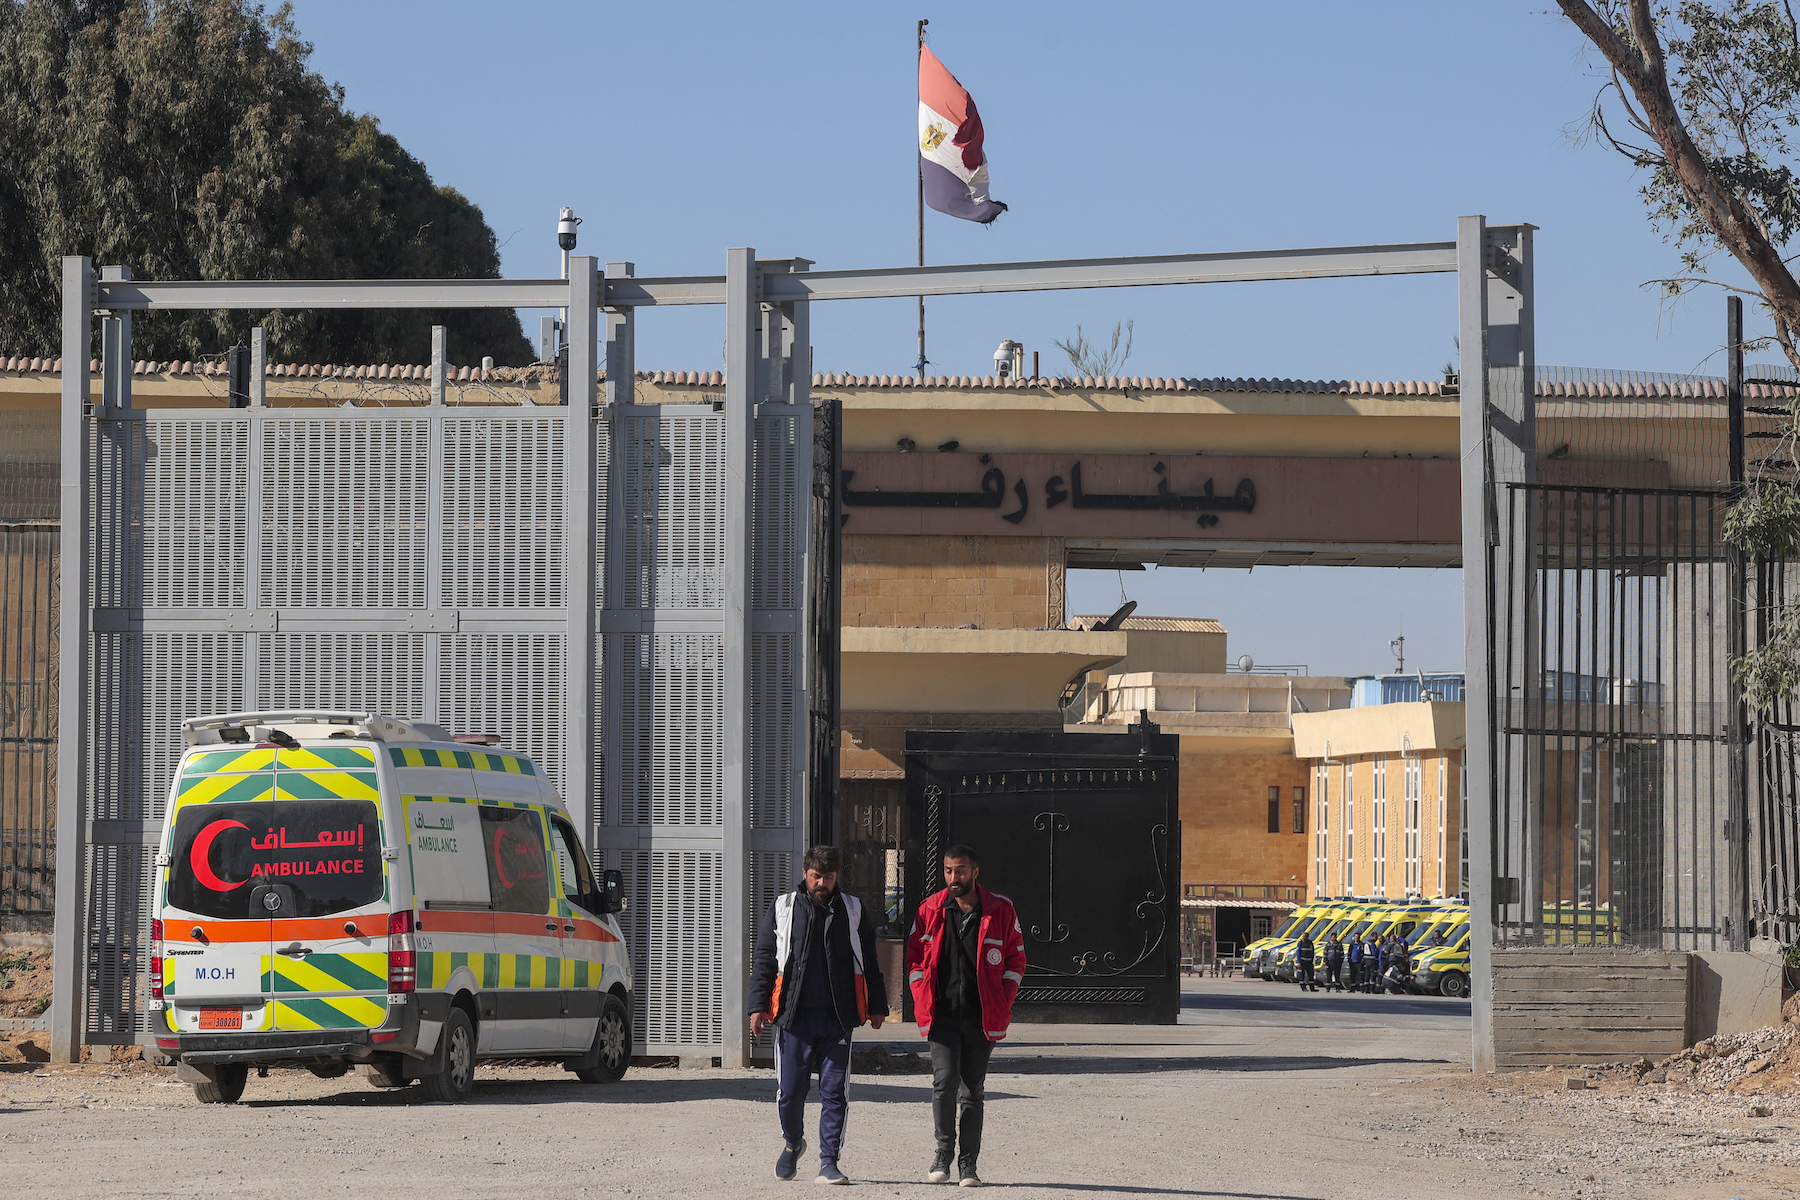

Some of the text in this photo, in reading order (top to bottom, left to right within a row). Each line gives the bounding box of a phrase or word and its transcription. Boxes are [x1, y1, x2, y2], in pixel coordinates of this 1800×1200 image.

[1045, 460, 1257, 528] ميناء
[250, 823, 364, 852] إسعاف
[418, 836, 458, 853] AMBULANCE
[250, 859, 364, 878] AMBULANCE
[195, 967, 235, 980] M.O.H
[215, 1017, 240, 1028] 308281
